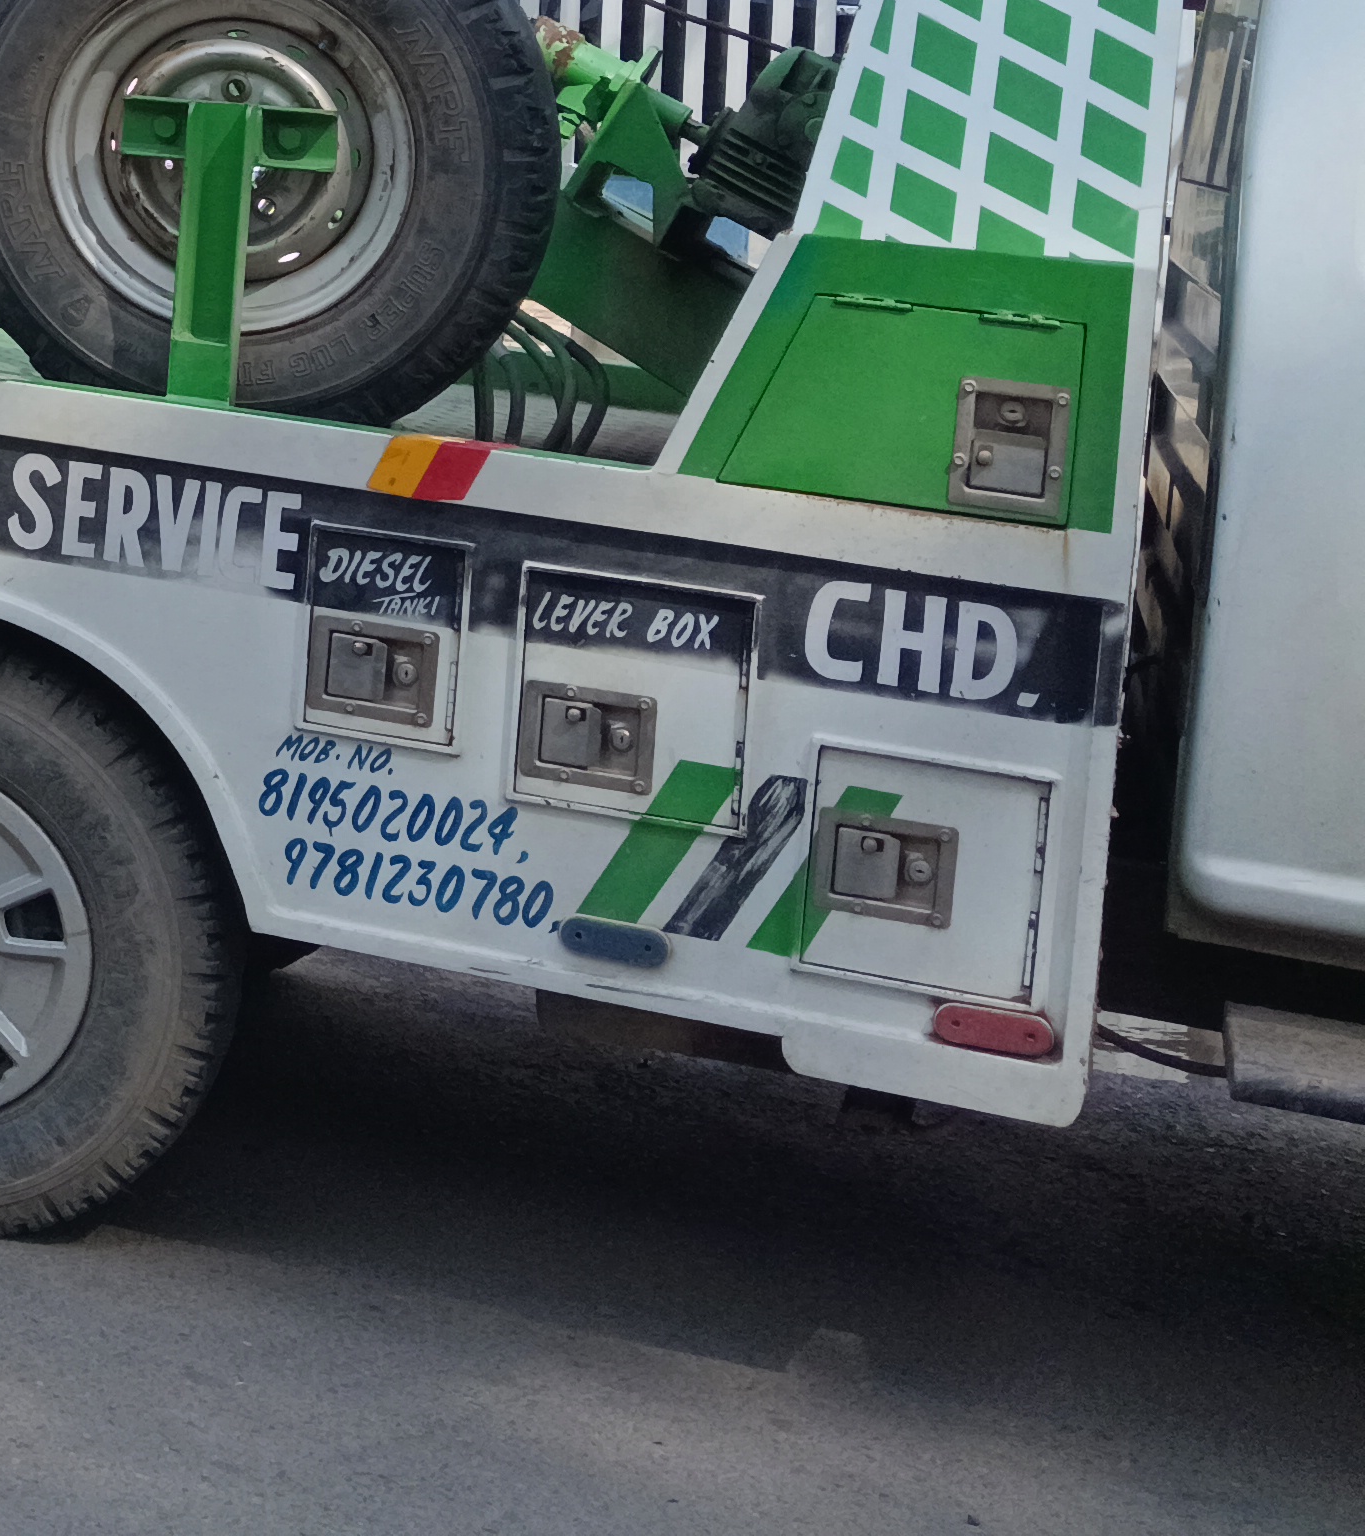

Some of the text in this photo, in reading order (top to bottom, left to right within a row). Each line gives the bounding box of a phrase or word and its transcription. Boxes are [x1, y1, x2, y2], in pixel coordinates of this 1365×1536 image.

[7, 452, 303, 591] SERVICE
[318, 546, 436, 595] DIESEL
[531, 590, 722, 651] LEVER BOX
[803, 579, 1041, 709] CHD.
[275, 732, 395, 776] MOB. NO.
